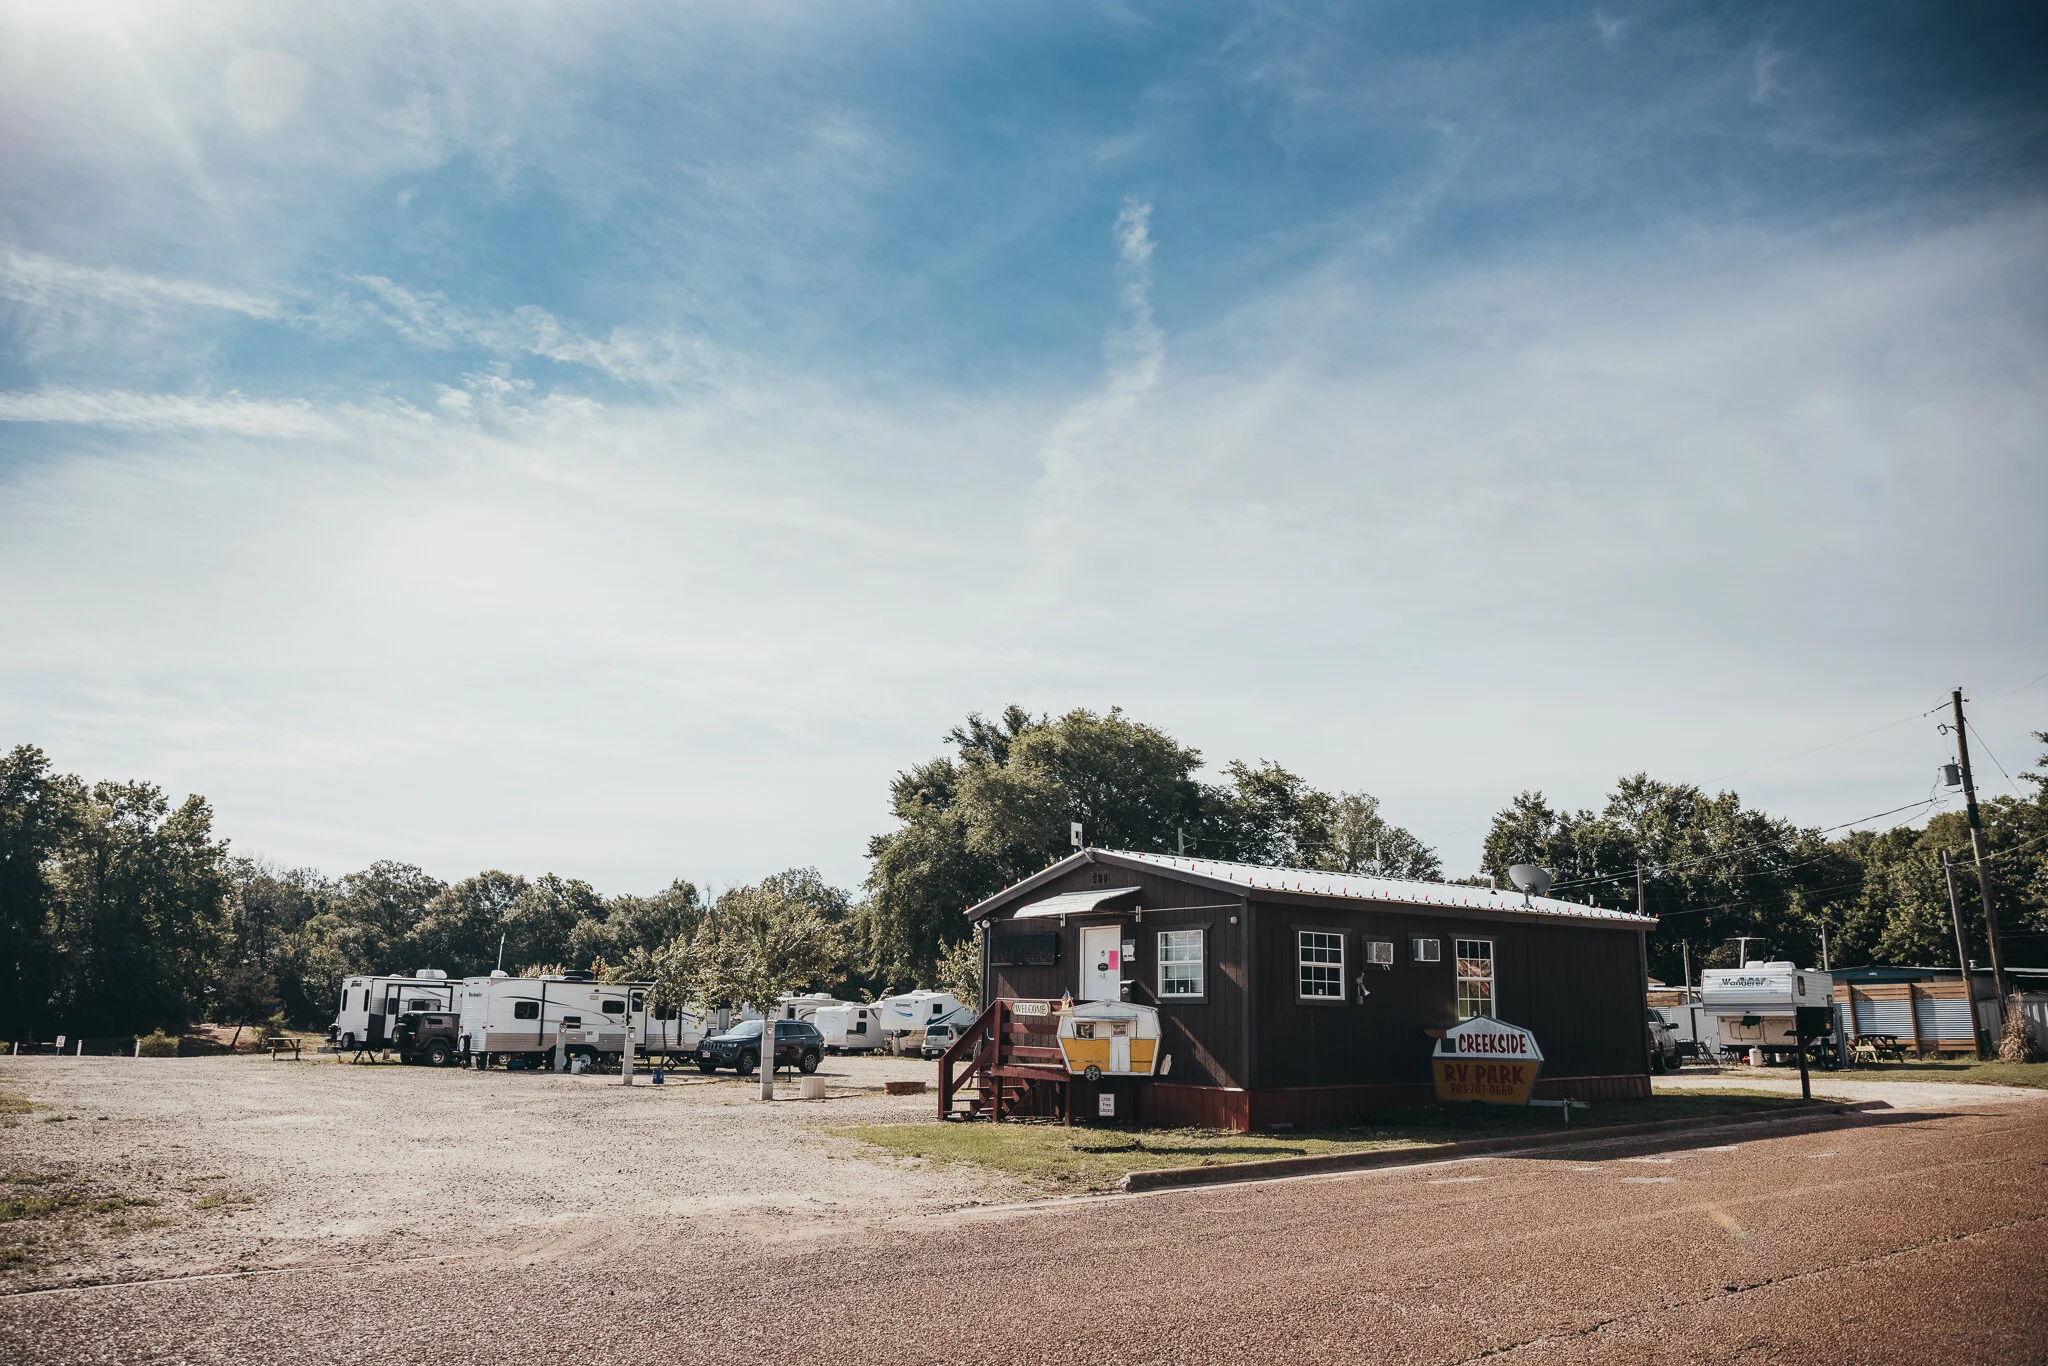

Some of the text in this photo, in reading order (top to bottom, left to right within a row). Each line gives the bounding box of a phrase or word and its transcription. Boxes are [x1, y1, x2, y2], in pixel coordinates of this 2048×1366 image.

[1721, 978, 1764, 986] Wanderer
[1015, 1004, 1047, 1014] WELCOME
[1458, 1033, 1527, 1054] CREEKSIDE
[1444, 1063, 1525, 1085] RV PARK
